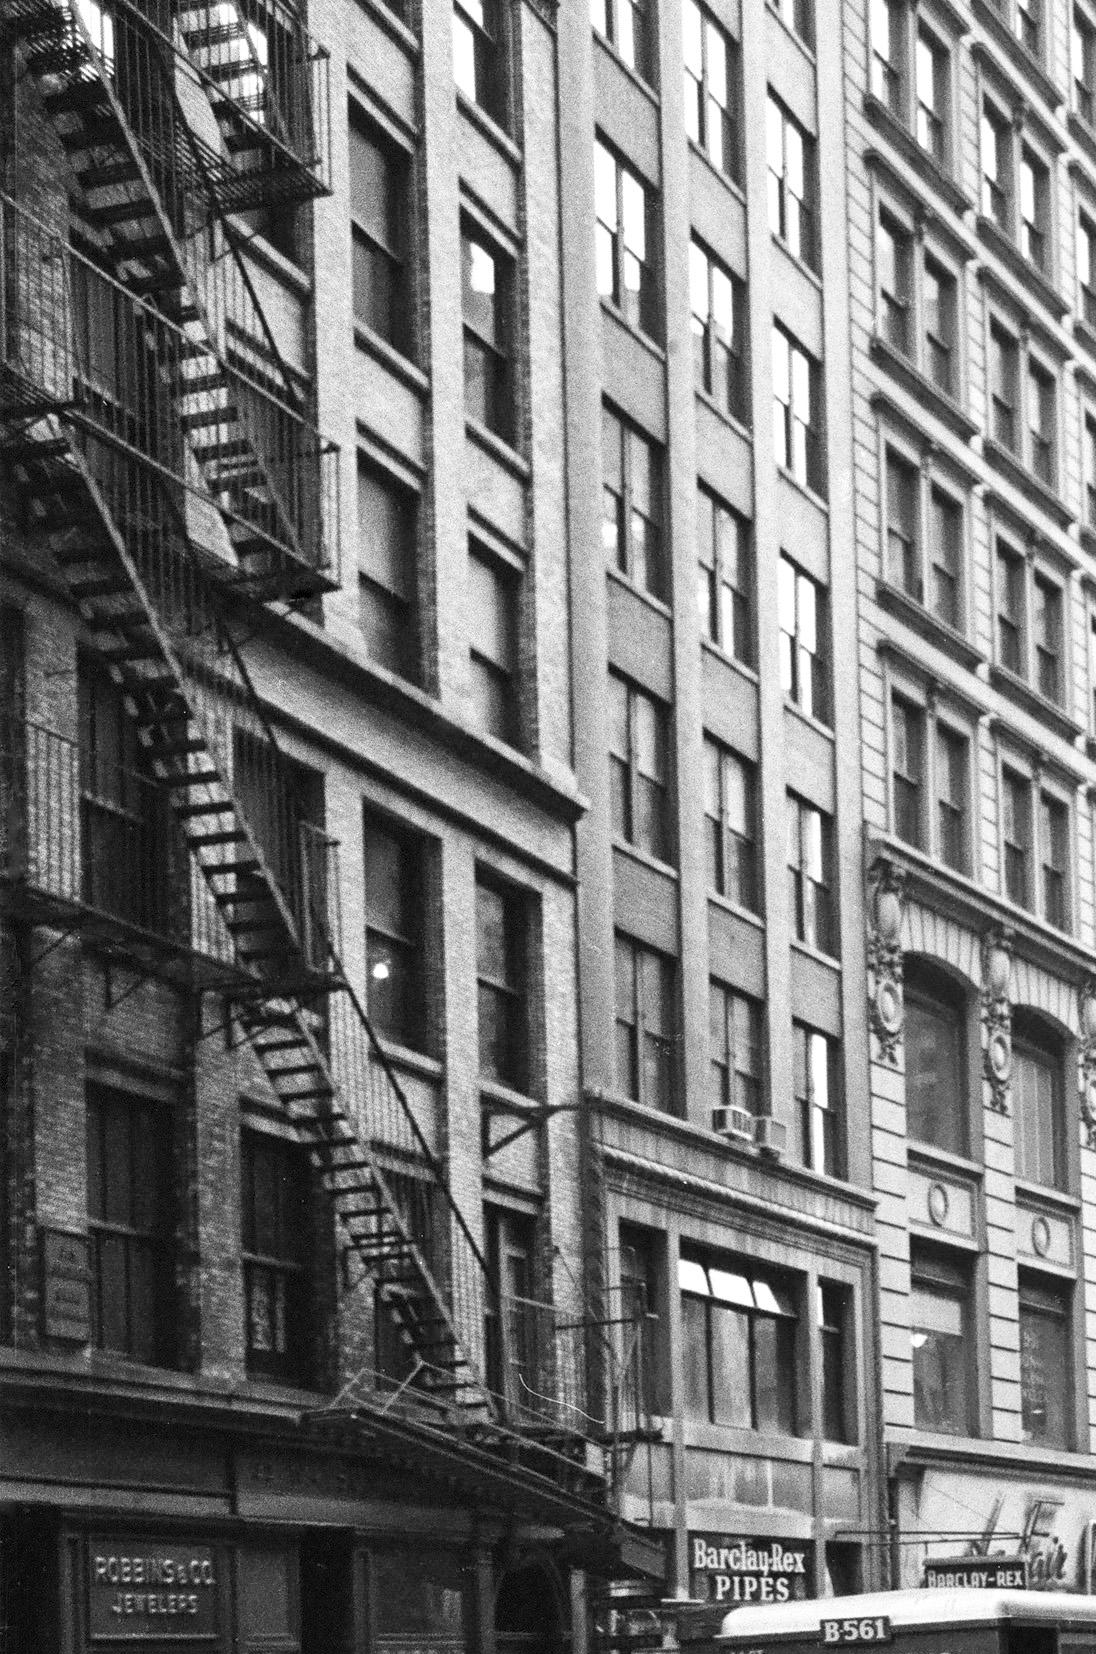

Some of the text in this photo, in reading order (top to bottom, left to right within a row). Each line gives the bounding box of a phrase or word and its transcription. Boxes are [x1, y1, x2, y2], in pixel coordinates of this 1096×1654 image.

[694, 1539, 805, 1576] Barclay-Rex
[715, 1575, 789, 1601] PIPES
[927, 1569, 1023, 1588] BARCLAY-REX
[111, 1593, 198, 1613] JEWELERS
[824, 1619, 886, 1642] B-561
